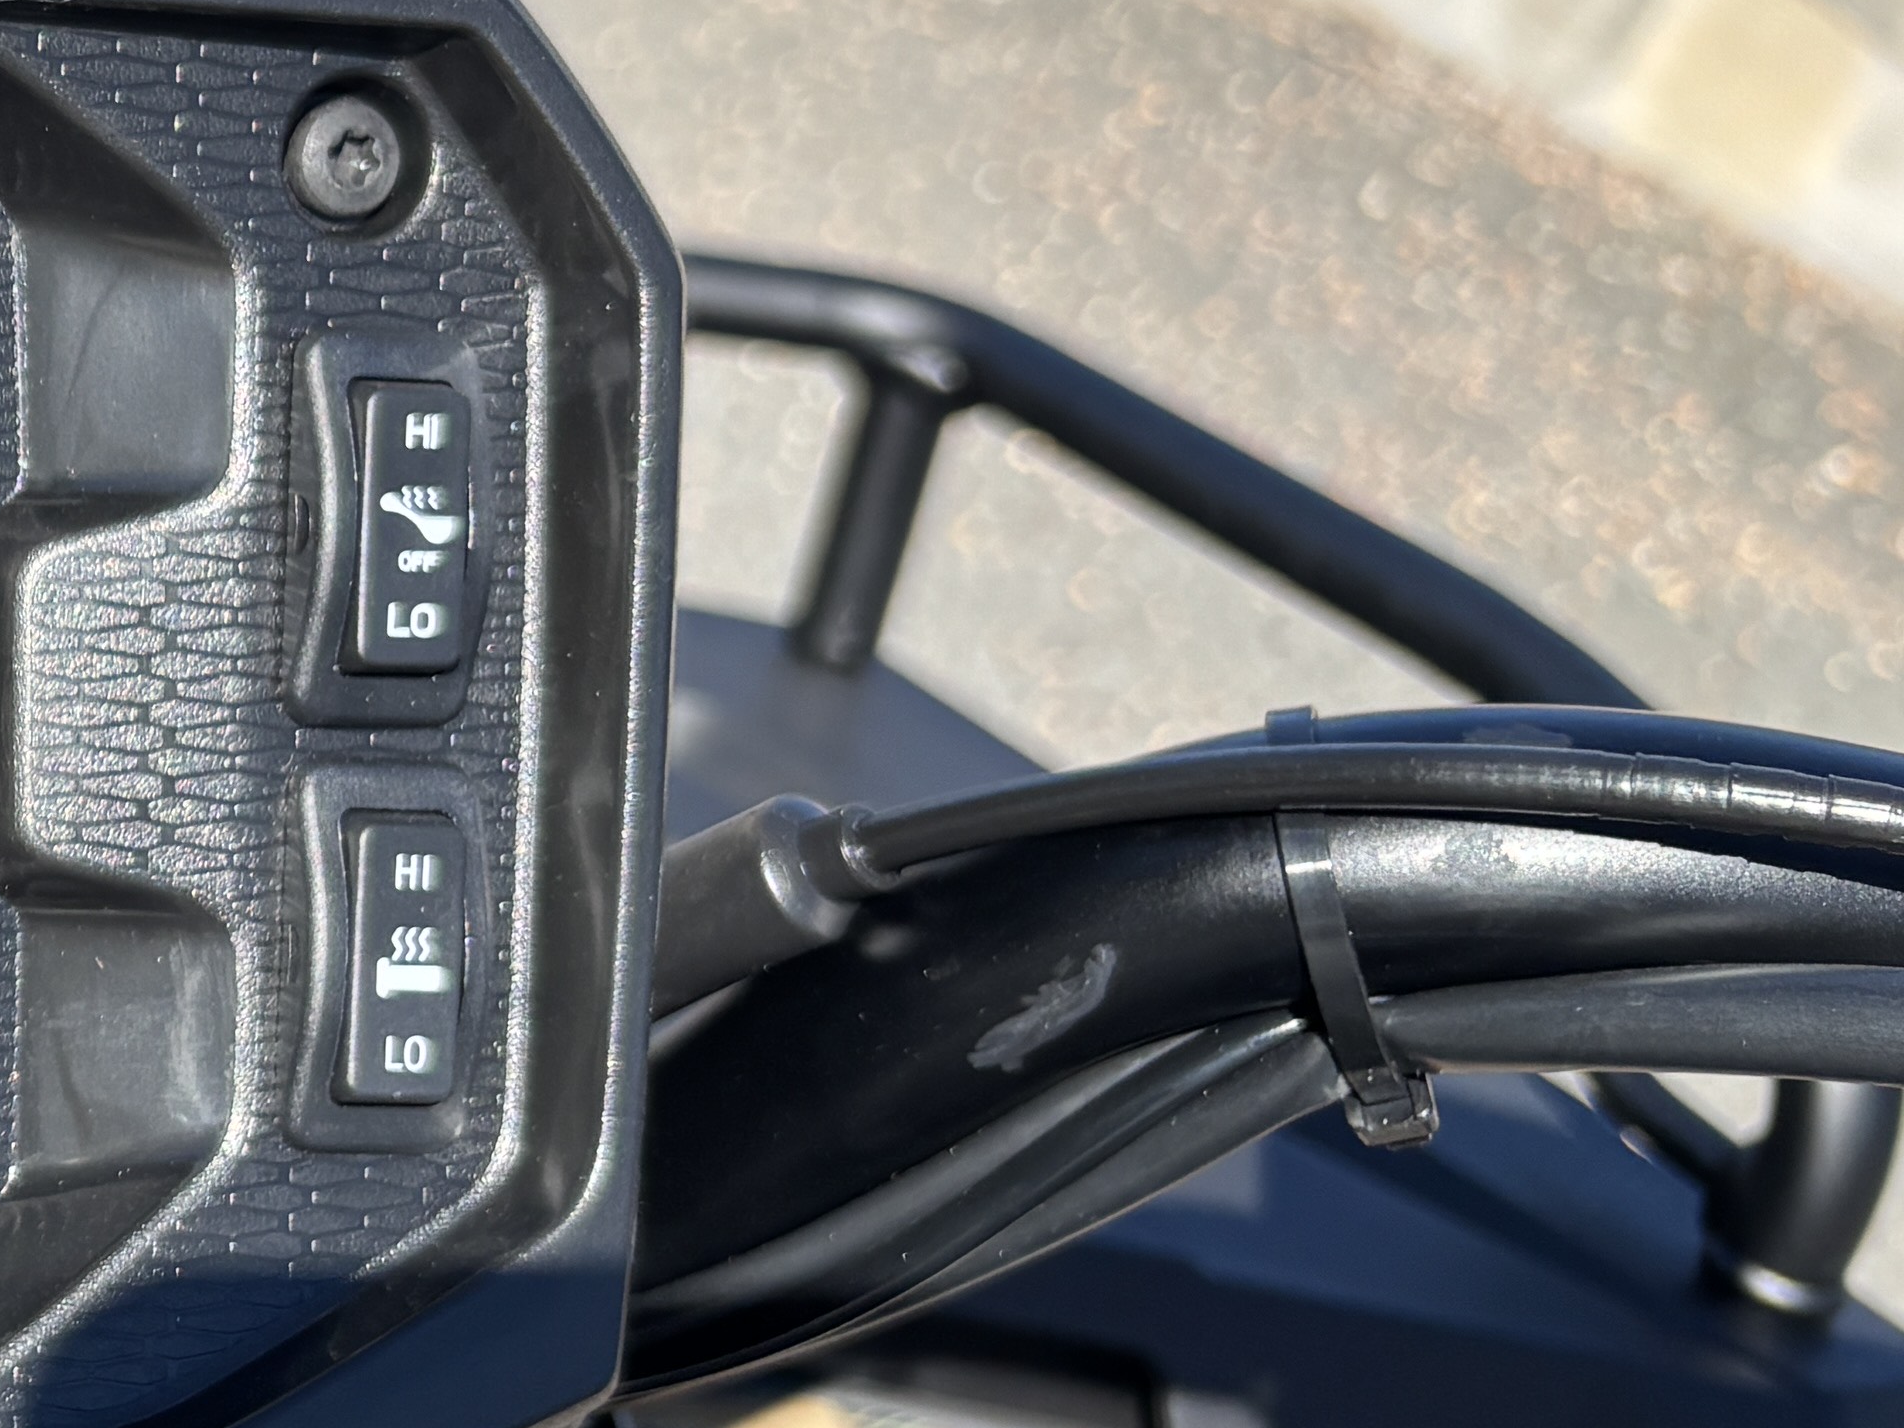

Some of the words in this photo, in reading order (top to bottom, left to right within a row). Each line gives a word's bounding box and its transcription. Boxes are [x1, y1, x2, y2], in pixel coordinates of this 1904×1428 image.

[405, 412, 448, 451] HI
[398, 549, 448, 573] OFF
[387, 601, 444, 639] LO
[395, 853, 441, 892] HI
[384, 1034, 435, 1074] LO
